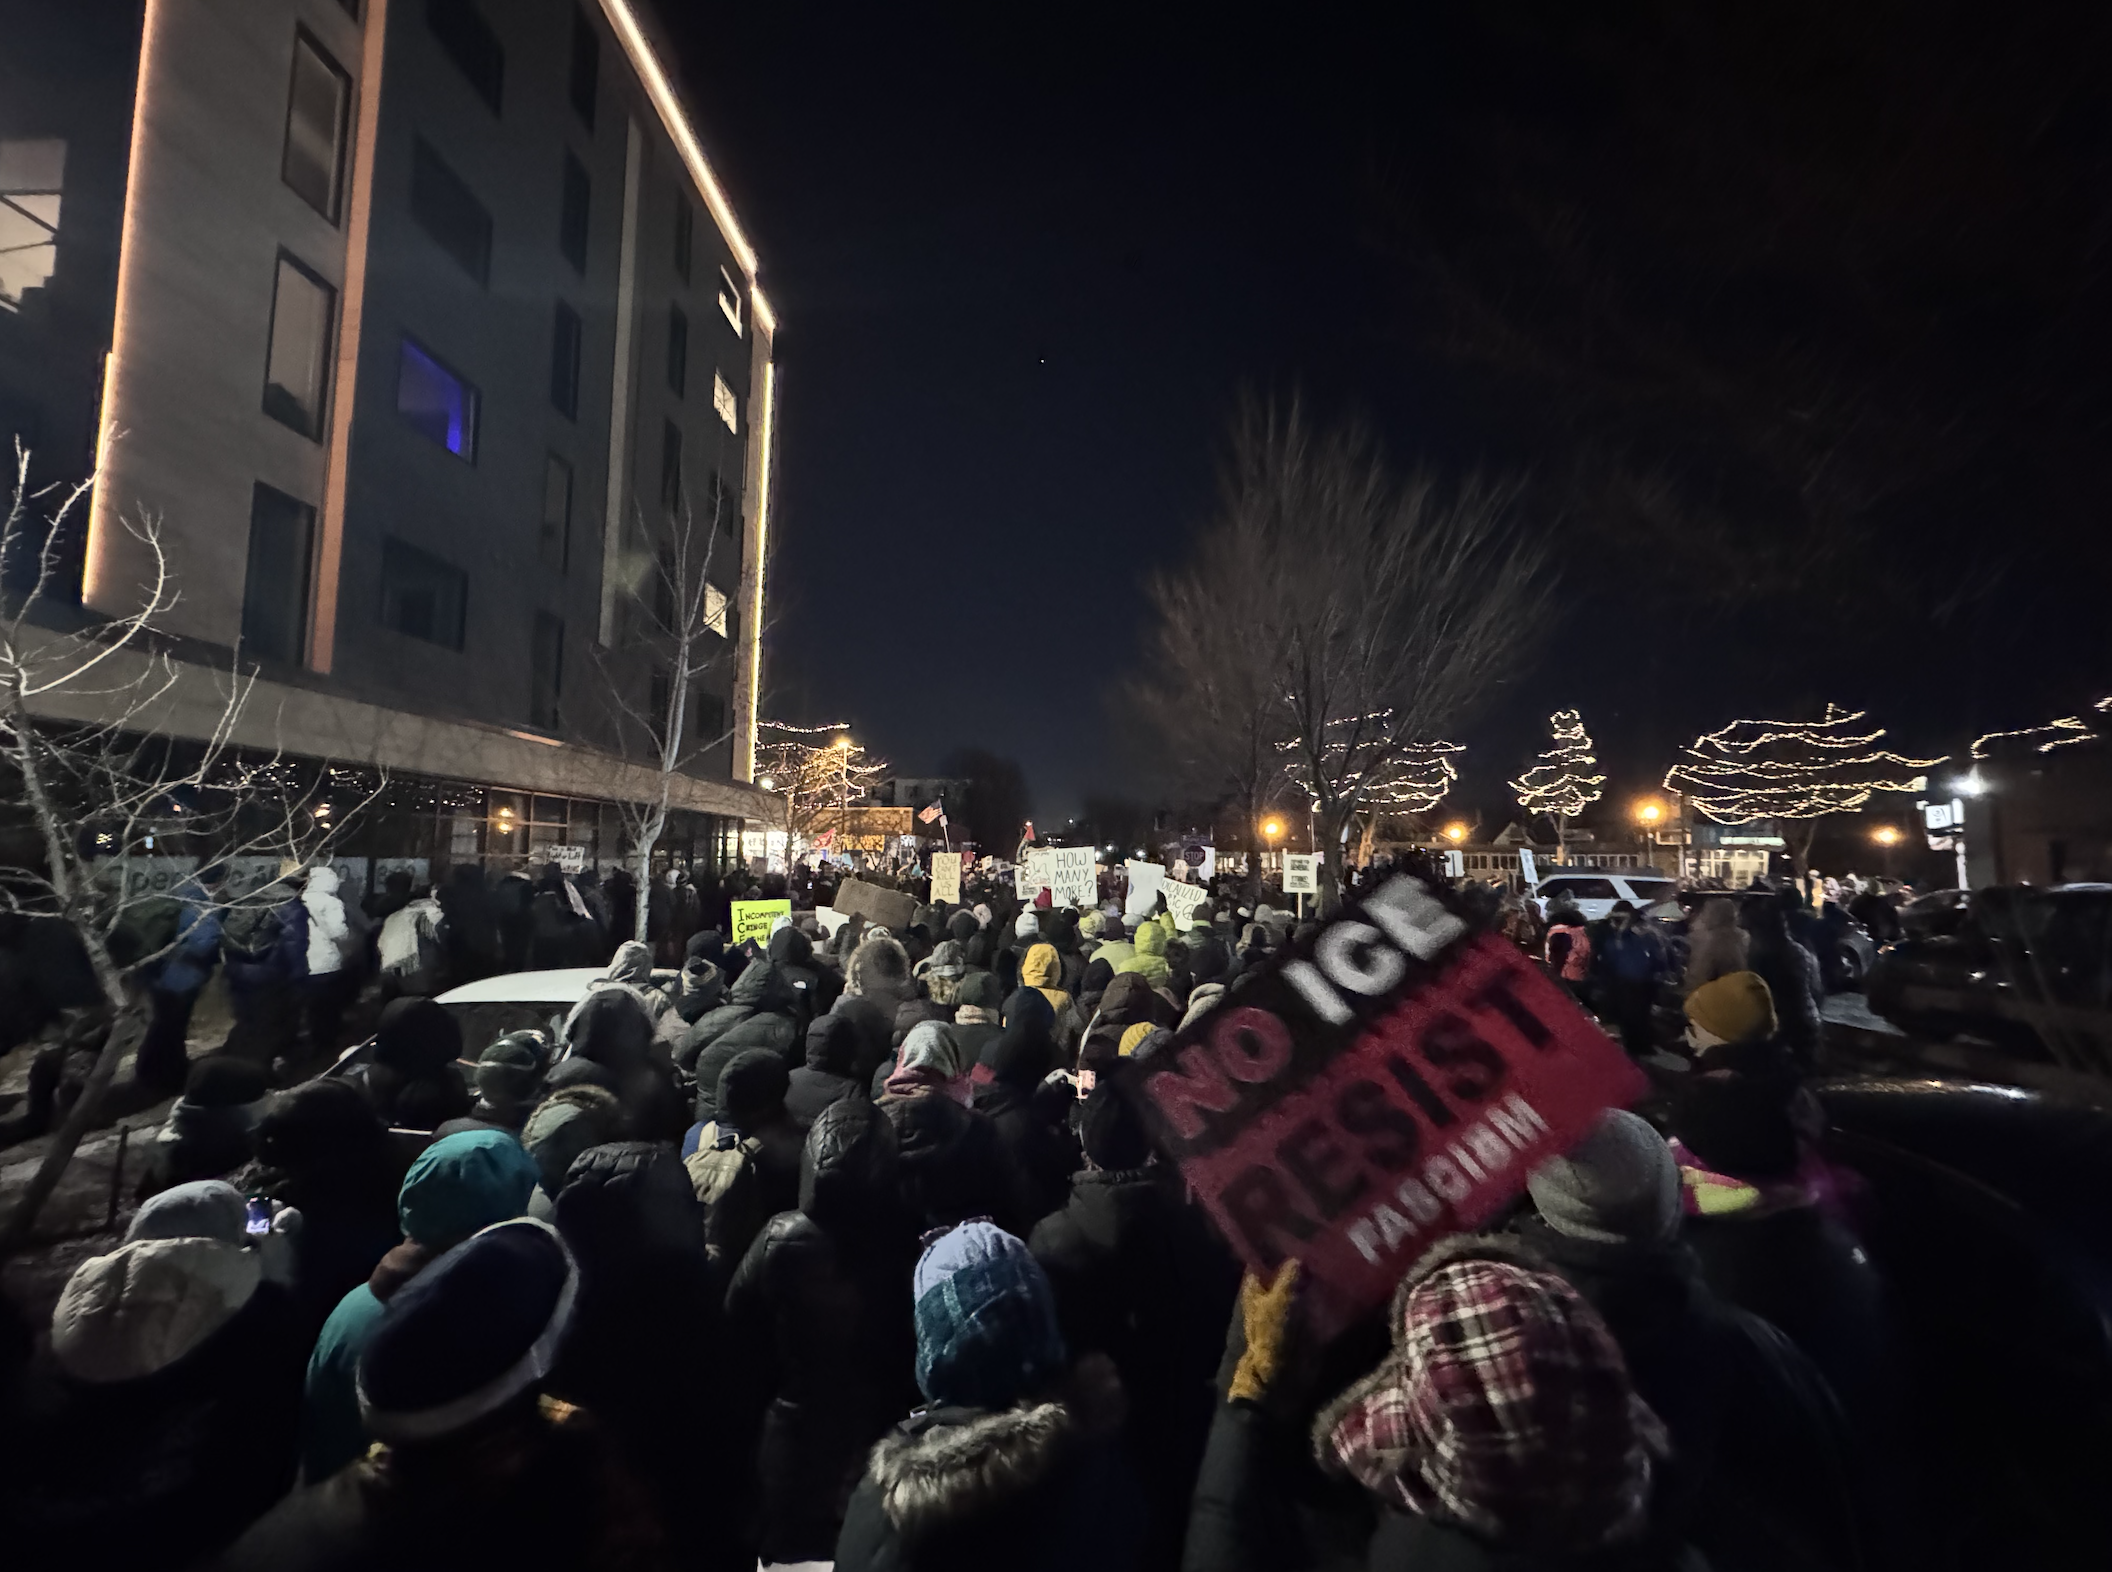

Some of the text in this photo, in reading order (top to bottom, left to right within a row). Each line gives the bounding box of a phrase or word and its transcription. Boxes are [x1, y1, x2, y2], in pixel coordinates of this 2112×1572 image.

[936, 855, 957, 867] YOU
[1056, 852, 1087, 868] HOW
[1185, 851, 1204, 860] STOP
[1054, 868, 1089, 884] MANY
[934, 888, 954, 896] ALL
[1054, 880, 1094, 900] MORE?
[1144, 872, 1469, 1139] NO ICE
[1219, 966, 1556, 1268] RESIST
